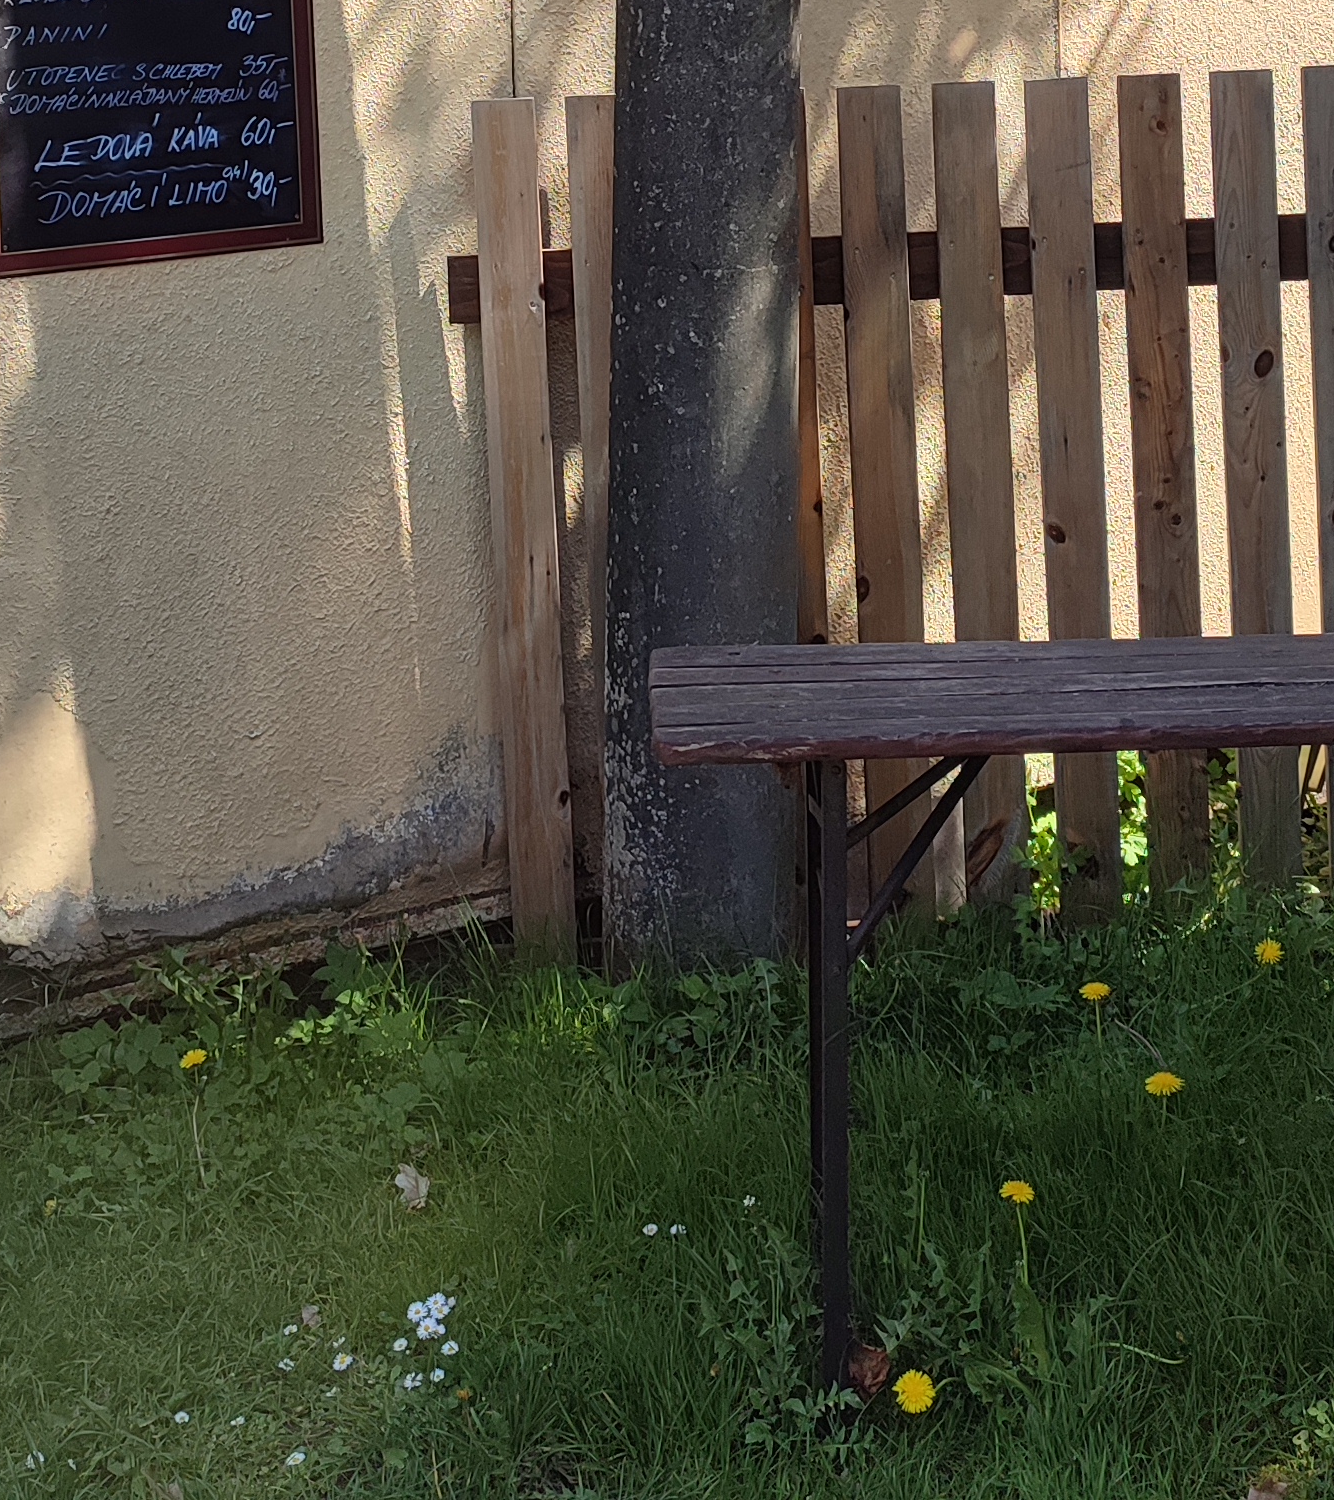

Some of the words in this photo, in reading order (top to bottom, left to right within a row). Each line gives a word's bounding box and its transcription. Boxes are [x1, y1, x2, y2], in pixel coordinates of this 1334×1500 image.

[2, 23, 107, 49] PANINI
[6, 64, 127, 91] UTOPENEC
[34, 113, 160, 172] LEDOVÁ
[168, 112, 219, 152] KÁVA
[168, 179, 227, 206] LIMO
